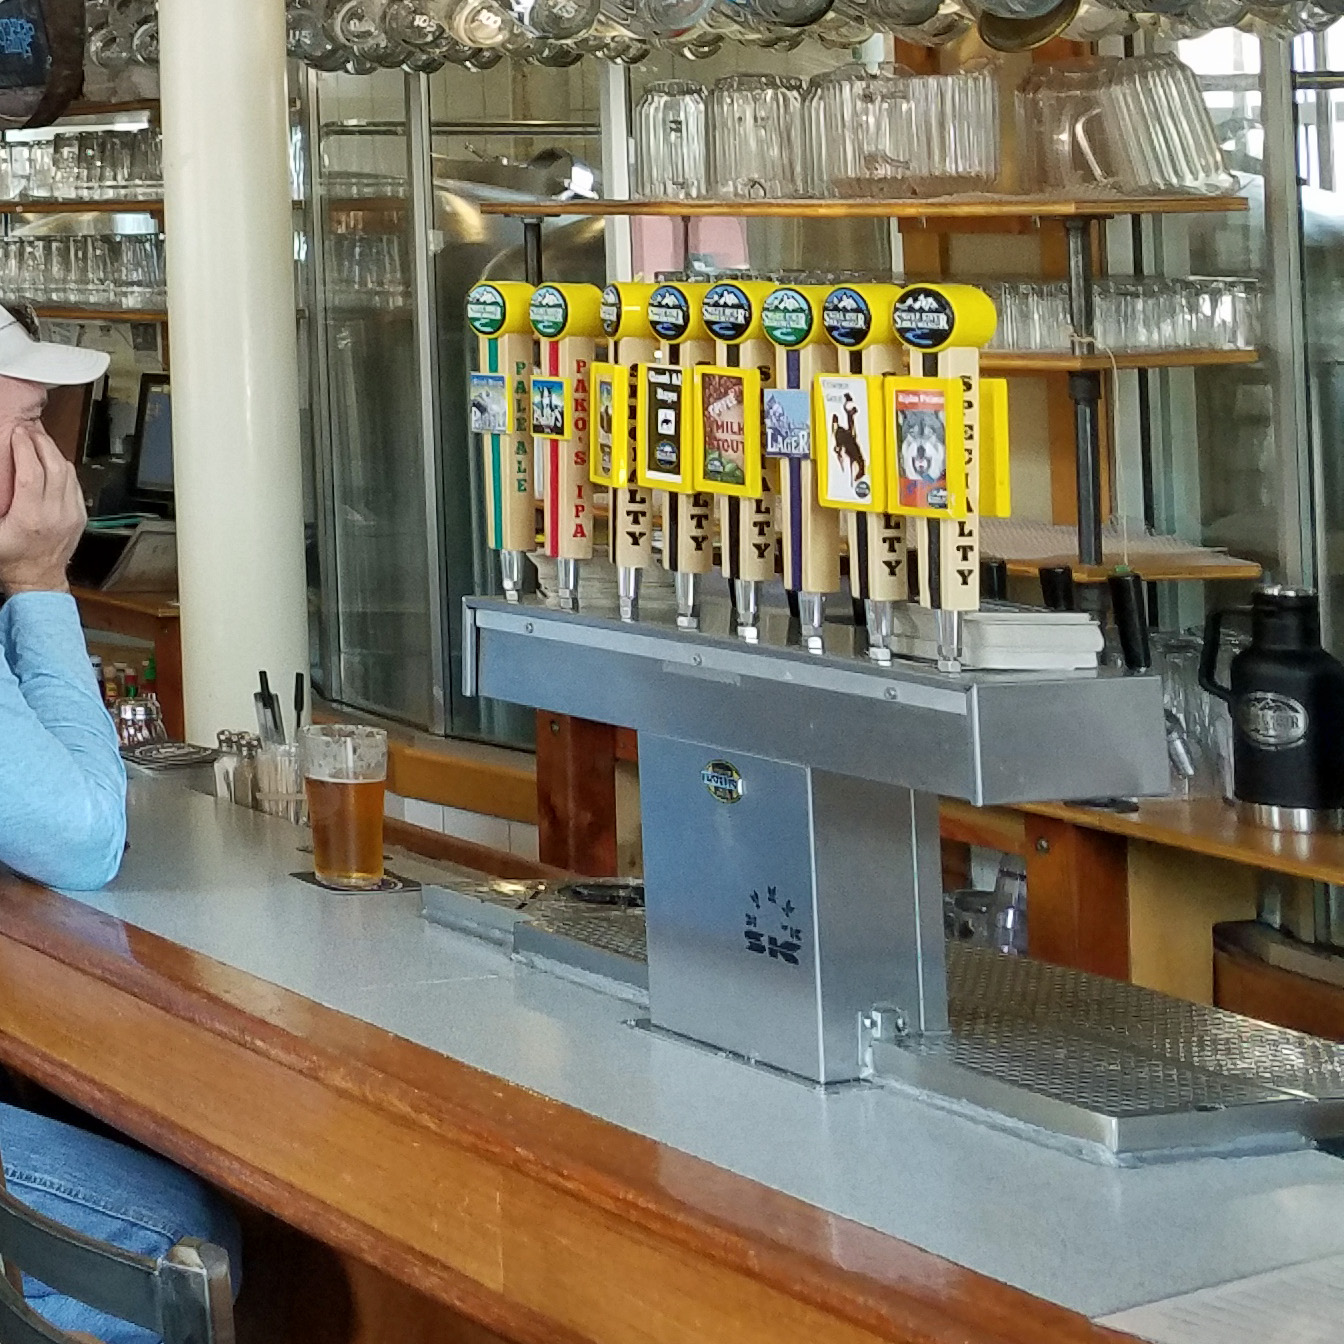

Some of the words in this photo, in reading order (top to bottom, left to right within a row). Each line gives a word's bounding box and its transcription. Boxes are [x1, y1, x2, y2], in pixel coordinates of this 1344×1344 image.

[514, 360, 528, 432] PALE
[573, 358, 589, 467] PAKO'S
[514, 440, 529, 494] ALE
[766, 427, 810, 455] LAGER
[572, 484, 588, 539] IPA
